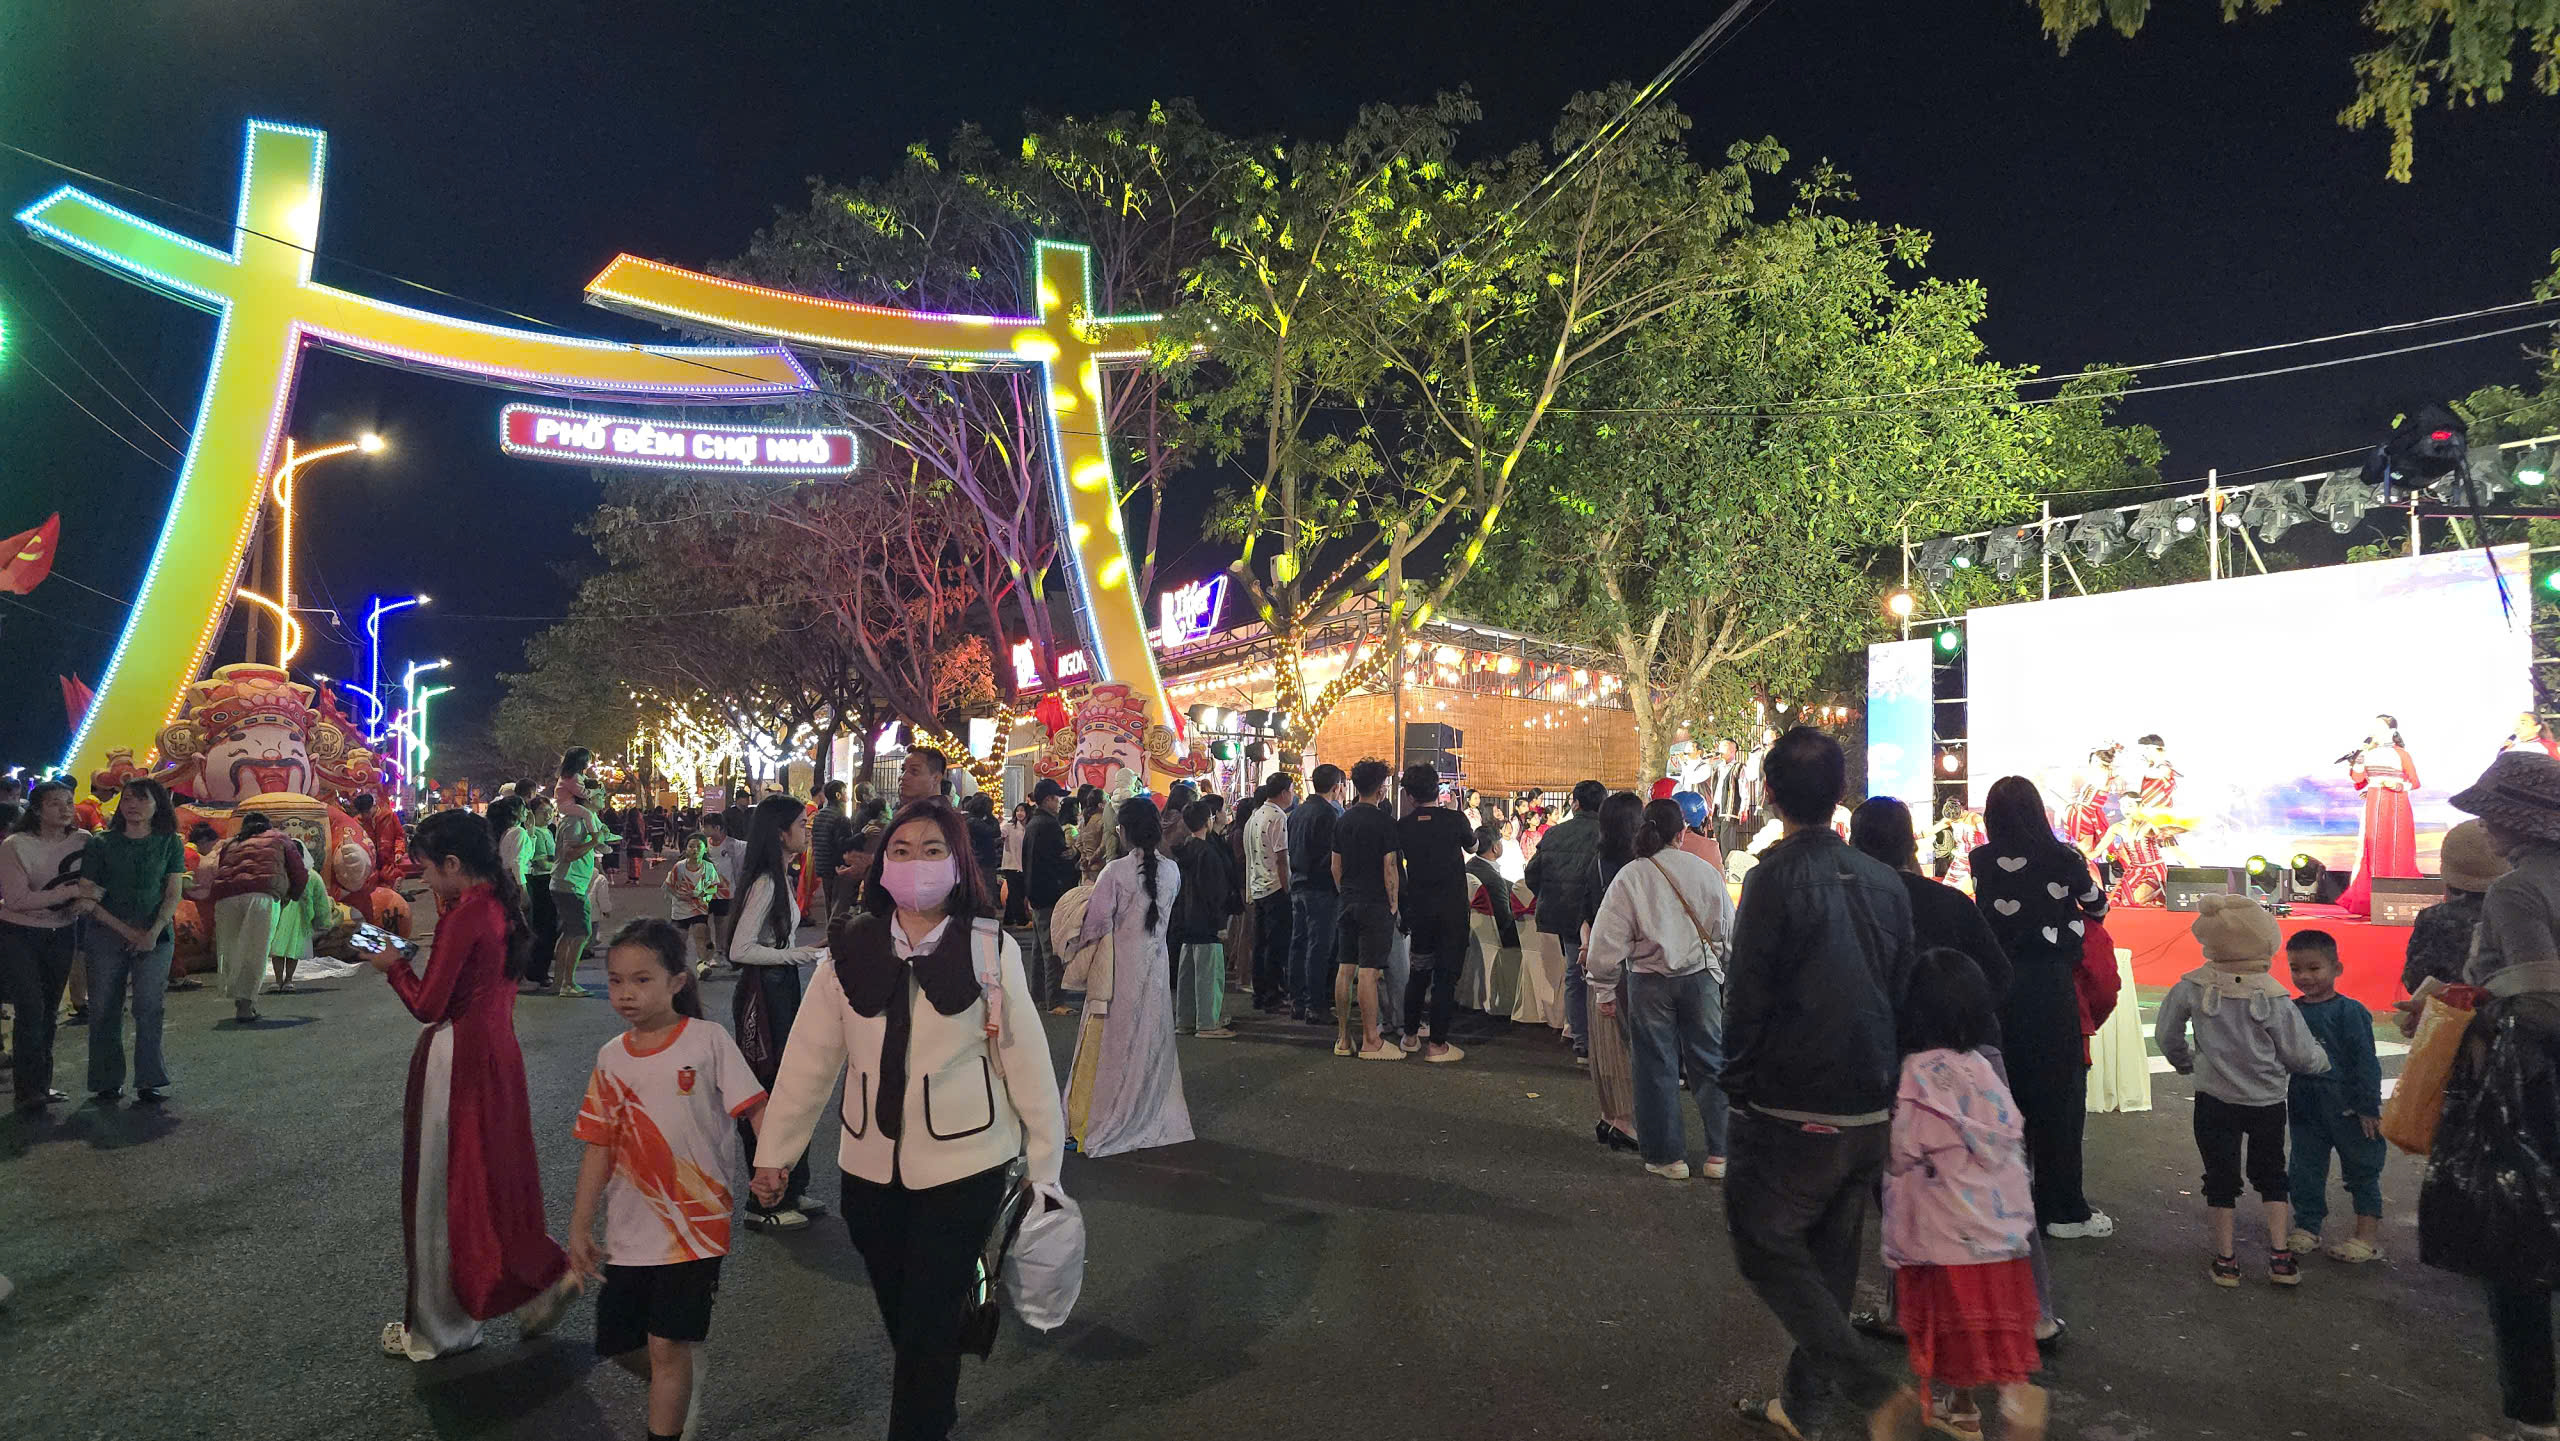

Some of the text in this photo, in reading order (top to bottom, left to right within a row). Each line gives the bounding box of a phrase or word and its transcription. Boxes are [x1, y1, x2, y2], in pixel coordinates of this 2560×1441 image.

[536, 418, 612, 449] PHỐ
[614, 423, 684, 456] ĐÊM
[693, 434, 757, 465] CHỢ
